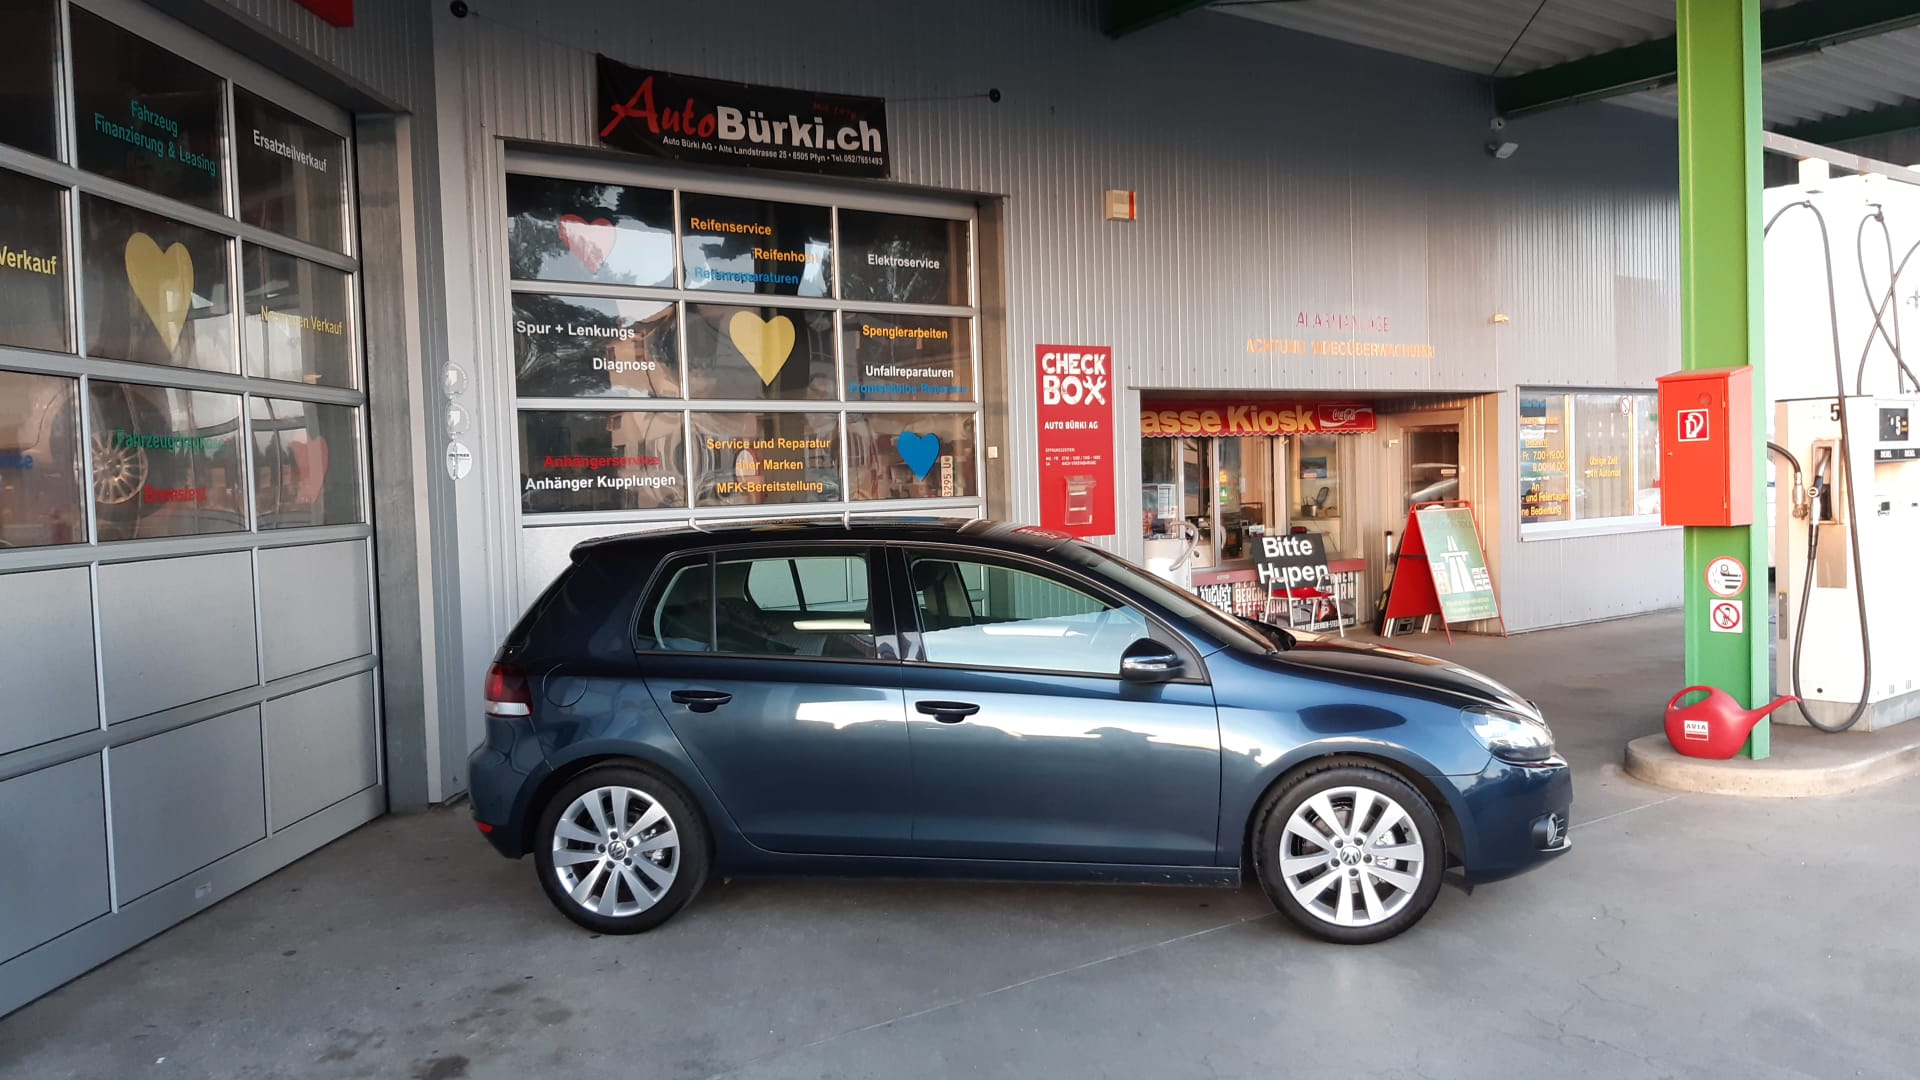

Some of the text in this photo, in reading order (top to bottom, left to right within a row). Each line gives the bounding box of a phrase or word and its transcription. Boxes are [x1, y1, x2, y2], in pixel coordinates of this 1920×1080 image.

[131, 99, 178, 138] Fahrzeug
[94, 112, 217, 177] Finanzierung & Leasing
[253, 129, 328, 174] Ersatzteilverkauf
[662, 135, 681, 147] Auto
[681, 138, 701, 150] Bürki
[701, 141, 713, 151] AG
[734, 146, 778, 160] Landstrasse
[792, 152, 809, 162] 8505
[690, 217, 772, 236] Reifenservice
[754, 247, 816, 263] Reifenho
[867, 254, 940, 270] Elektroservice
[694, 266, 799, 285] Reifenreparaturen
[310, 315, 343, 337] Verkauf
[516, 320, 635, 341] Spur + Lenkungs
[862, 325, 948, 340] Spenglerarbeiten
[1246, 338, 1306, 355] ACHTUNG
[592, 357, 656, 374] Diagnose
[865, 364, 954, 379] Unfallreparaturen
[1042, 353, 1106, 375] CHECK
[1042, 375, 1107, 406] BOX
[1227, 405, 1316, 433] Kiosk
[1830, 403, 1841, 421] 5
[1044, 419, 1098, 430] AUTO BÜRKI AG
[706, 437, 831, 451] Service und Reparatur
[543, 454, 661, 470] Anhängerservice
[763, 459, 803, 470] Marken
[525, 475, 676, 491] Anhänger Kupplungen
[716, 481, 823, 494] MFK-Bereitstellung
[943, 473, 952, 497] 3295
[1261, 536, 1313, 559] Bitte
[1257, 562, 1329, 588] Hupen
[1200, 588, 1232, 603] AUGUST
[1686, 723, 1707, 731] AVIA
